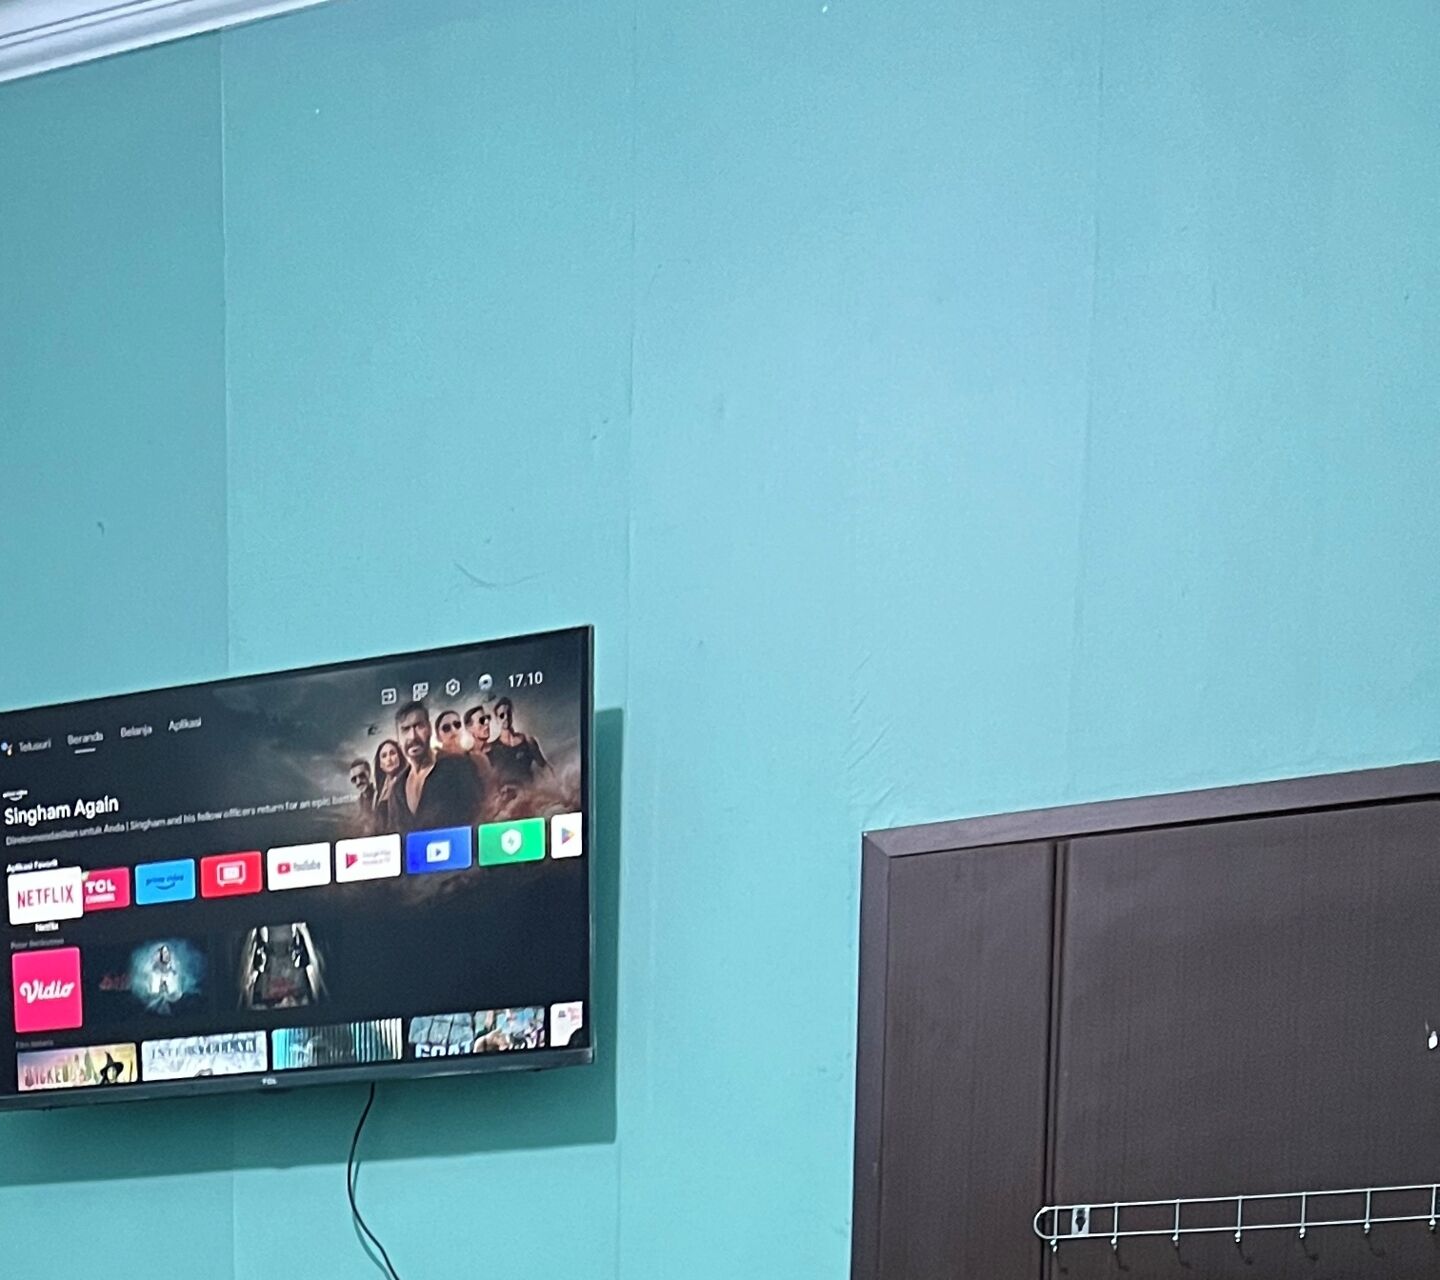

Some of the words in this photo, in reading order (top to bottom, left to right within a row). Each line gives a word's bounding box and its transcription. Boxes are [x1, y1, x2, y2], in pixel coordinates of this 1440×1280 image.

[508, 671, 543, 688] 17.10
[120, 724, 153, 739] Belanja
[168, 717, 202, 732] Aplikasi
[67, 731, 104, 746] Beranda
[4, 803, 71, 827] Singham
[74, 795, 119, 820] Again
[103, 823, 125, 834] Anda
[130, 817, 166, 832] Singham
[166, 813, 183, 825] and
[183, 811, 196, 823] his
[197, 808, 223, 822] fellow
[223, 805, 256, 819] officers
[256, 803, 285, 815] return
[285, 800, 299, 811] for
[299, 801, 311, 810] an
[85, 879, 117, 894] TCL
[17, 884, 75, 910] NETFLIX
[19, 979, 76, 1004] Vidio
